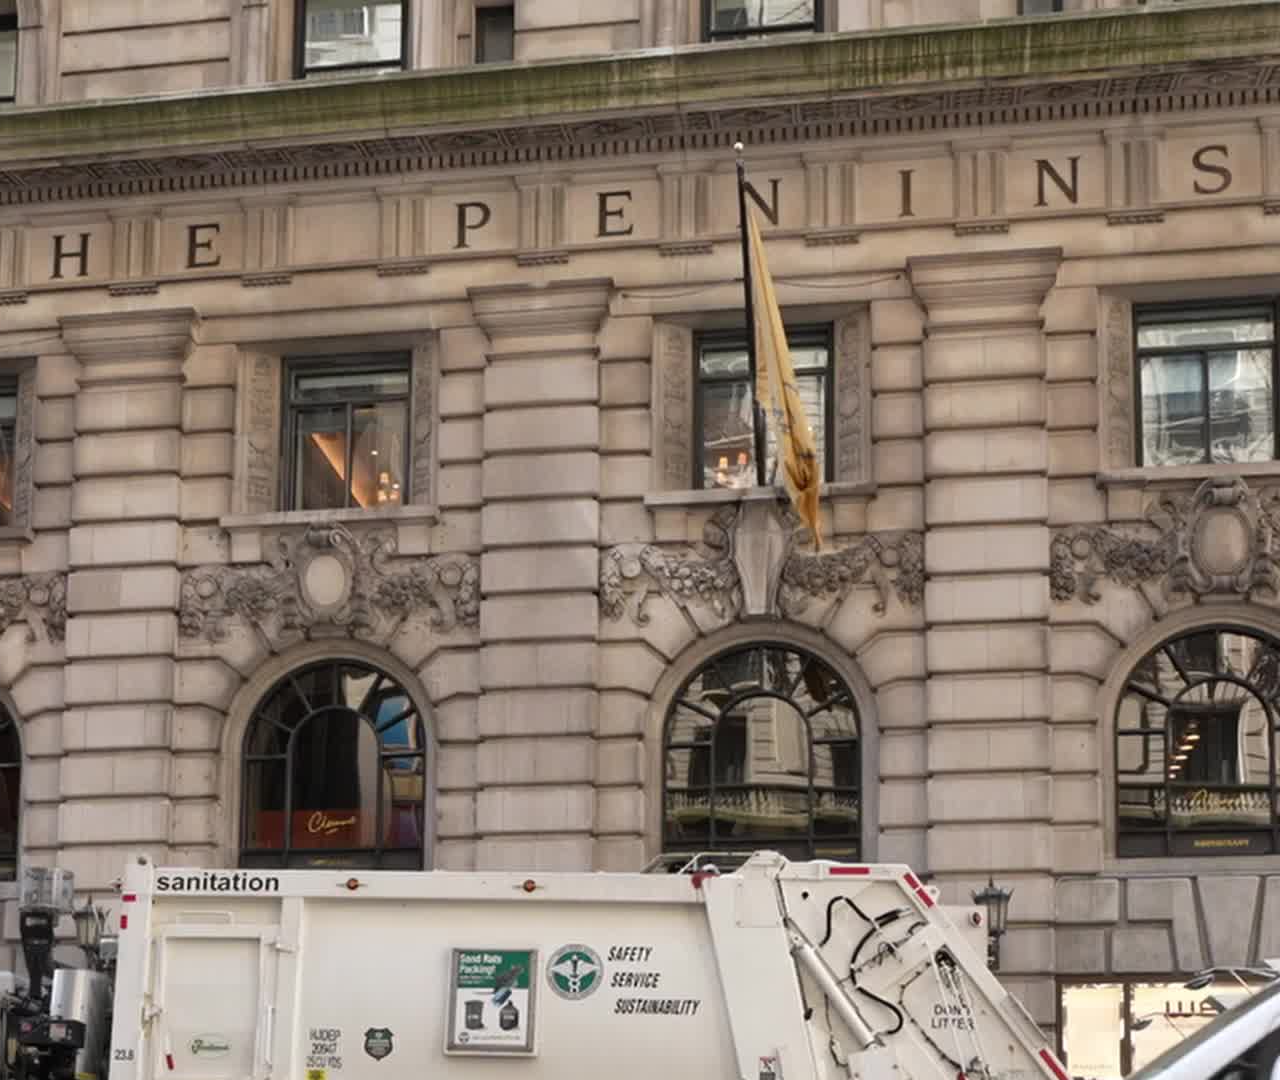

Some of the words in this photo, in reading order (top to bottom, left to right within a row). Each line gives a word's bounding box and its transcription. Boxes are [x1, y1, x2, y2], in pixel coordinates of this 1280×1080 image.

[157, 873, 280, 893] sanitation
[608, 946, 653, 962] SAFETY
[611, 972, 661, 989] SERVICE
[614, 998, 701, 1016] SUSTAINABILITY
